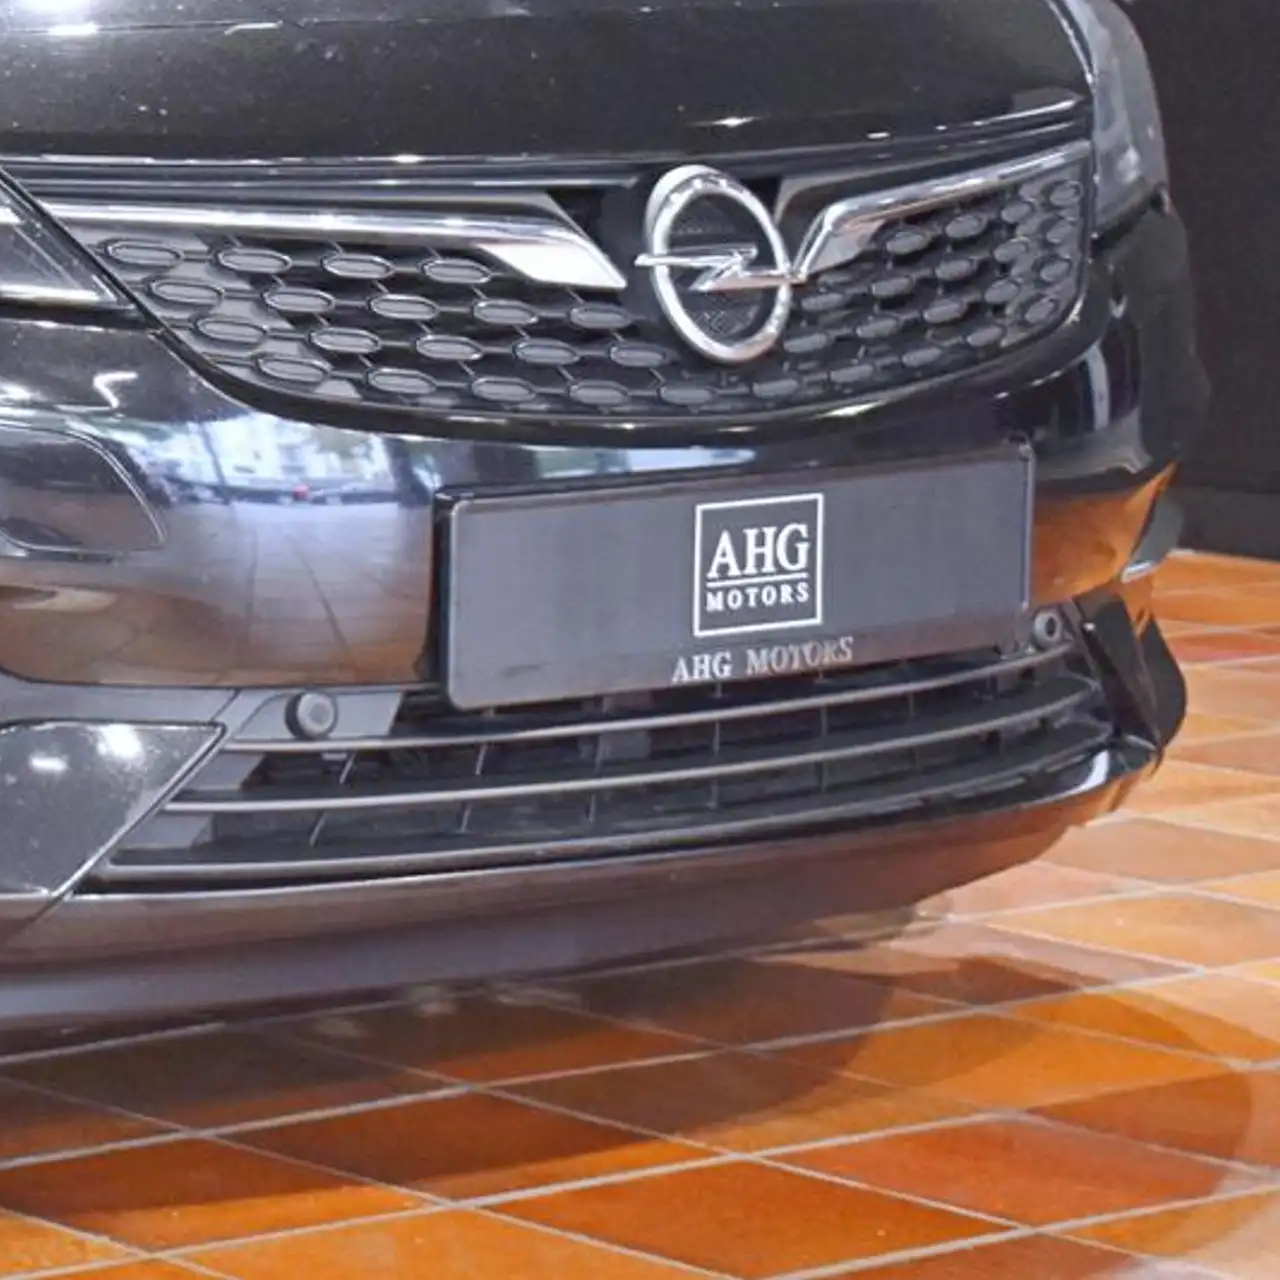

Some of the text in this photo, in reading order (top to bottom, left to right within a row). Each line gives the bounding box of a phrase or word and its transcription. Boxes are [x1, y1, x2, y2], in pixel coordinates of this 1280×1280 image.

[706, 524, 810, 579] AHG
[706, 582, 810, 613] MOTORS
[671, 636, 854, 684] AHG MOTORS
